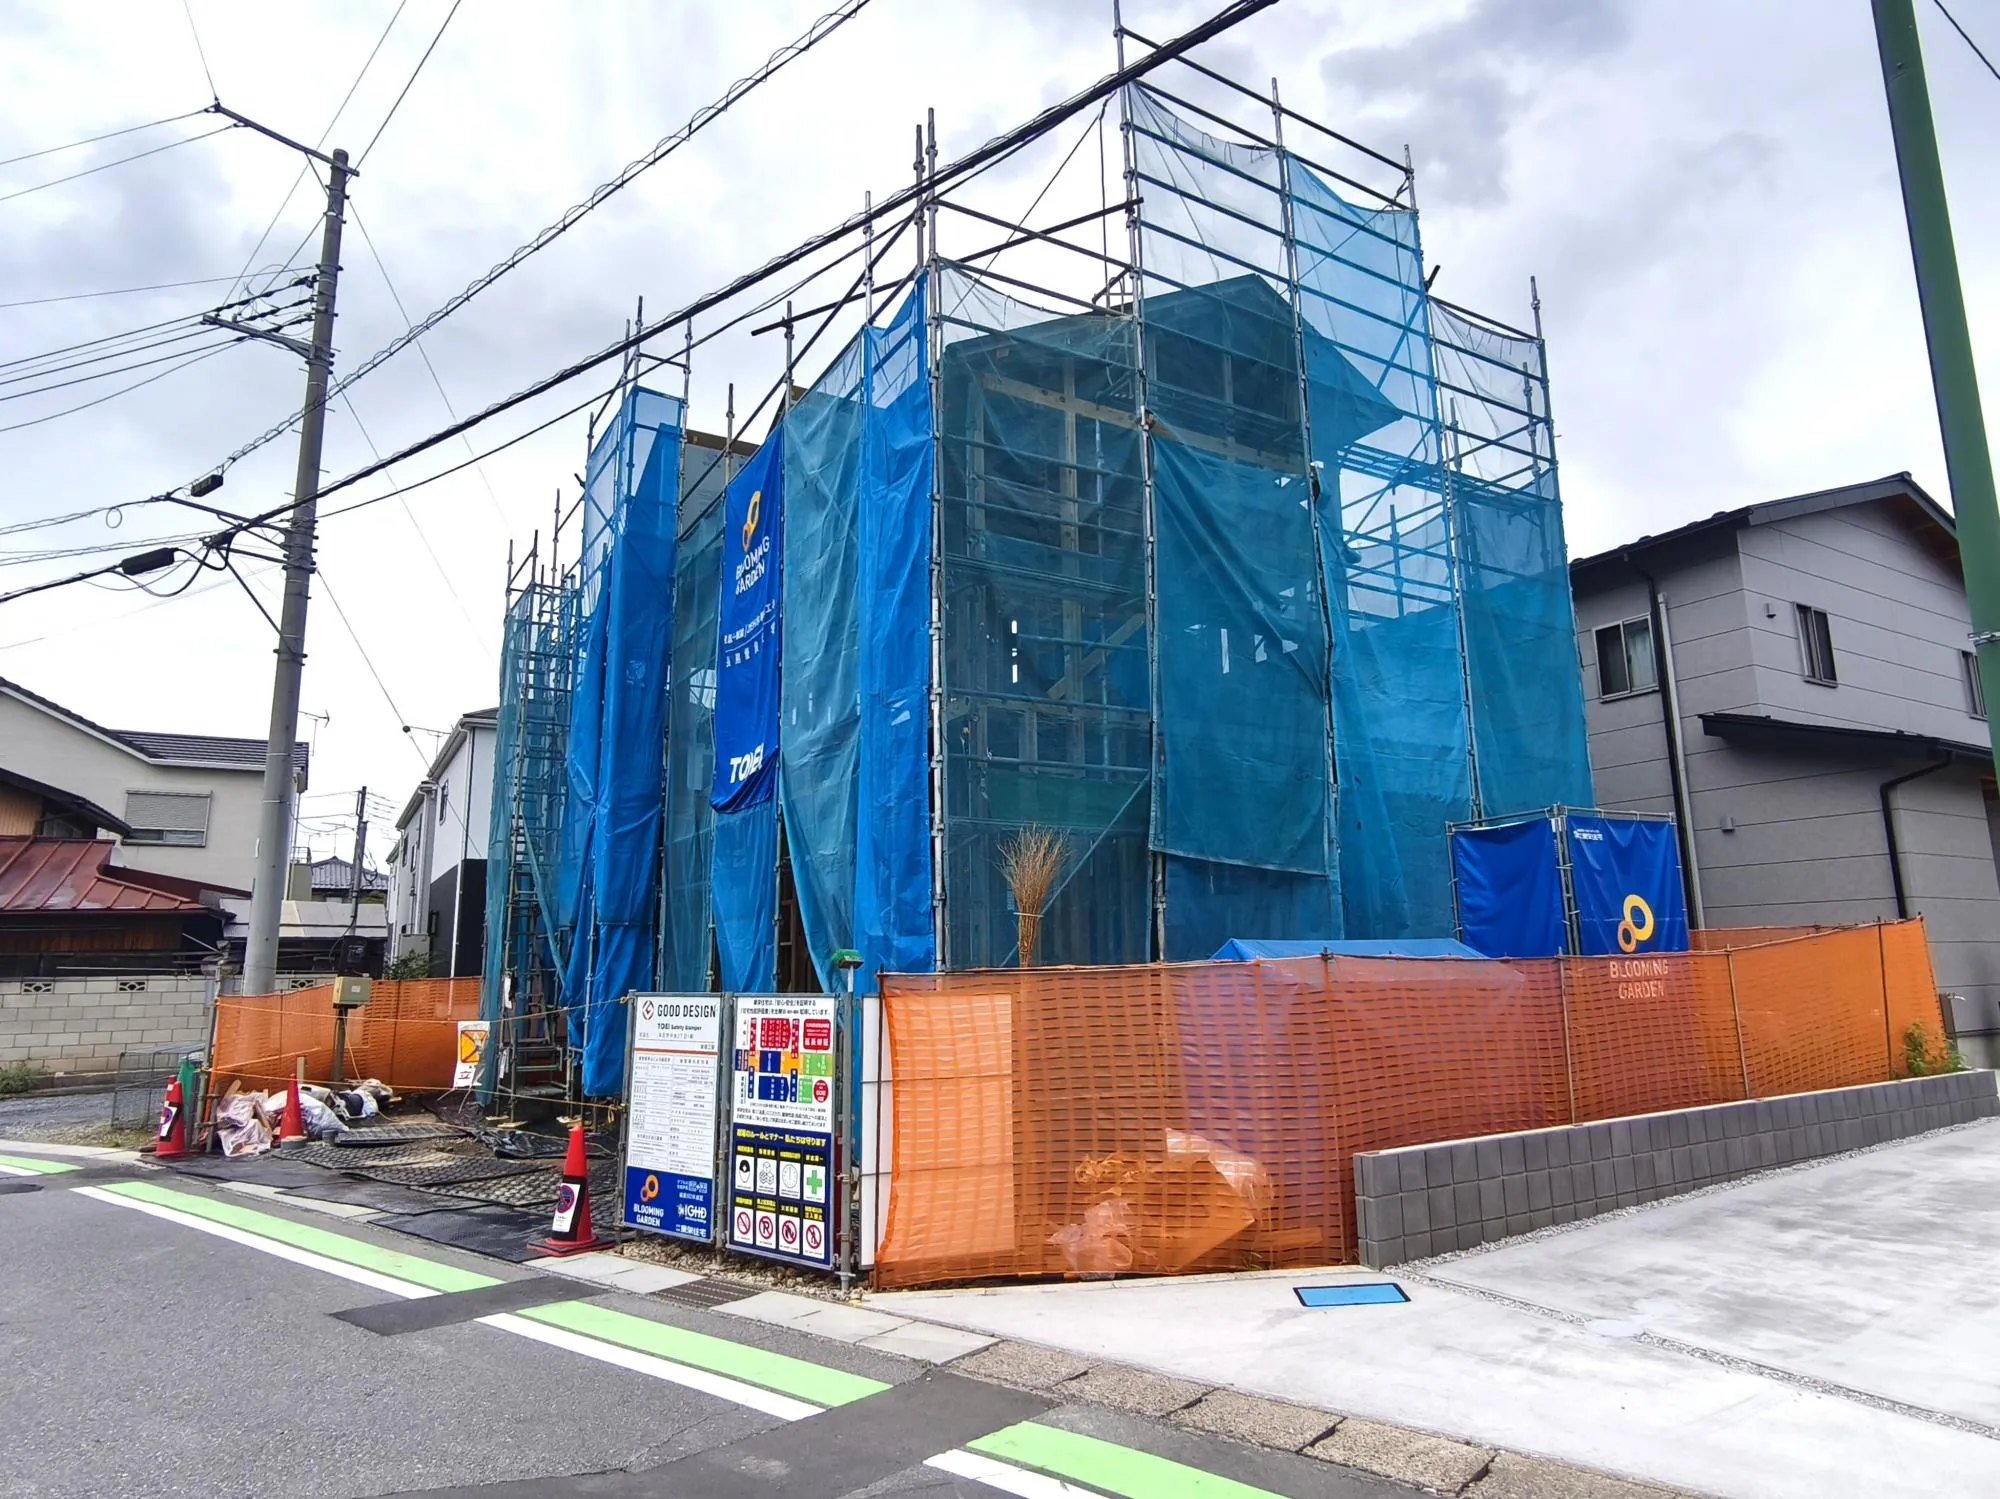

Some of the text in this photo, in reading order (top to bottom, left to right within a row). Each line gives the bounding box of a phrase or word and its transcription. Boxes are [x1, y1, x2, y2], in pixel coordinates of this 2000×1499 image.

[1609, 959, 1670, 978] BLOOMING
[1618, 980, 1665, 999] GARDEN
[657, 1004, 717, 1018] GOOD DESIGN
[633, 1203, 664, 1218] BLOOMING
[636, 1214, 661, 1227] GARDEN
